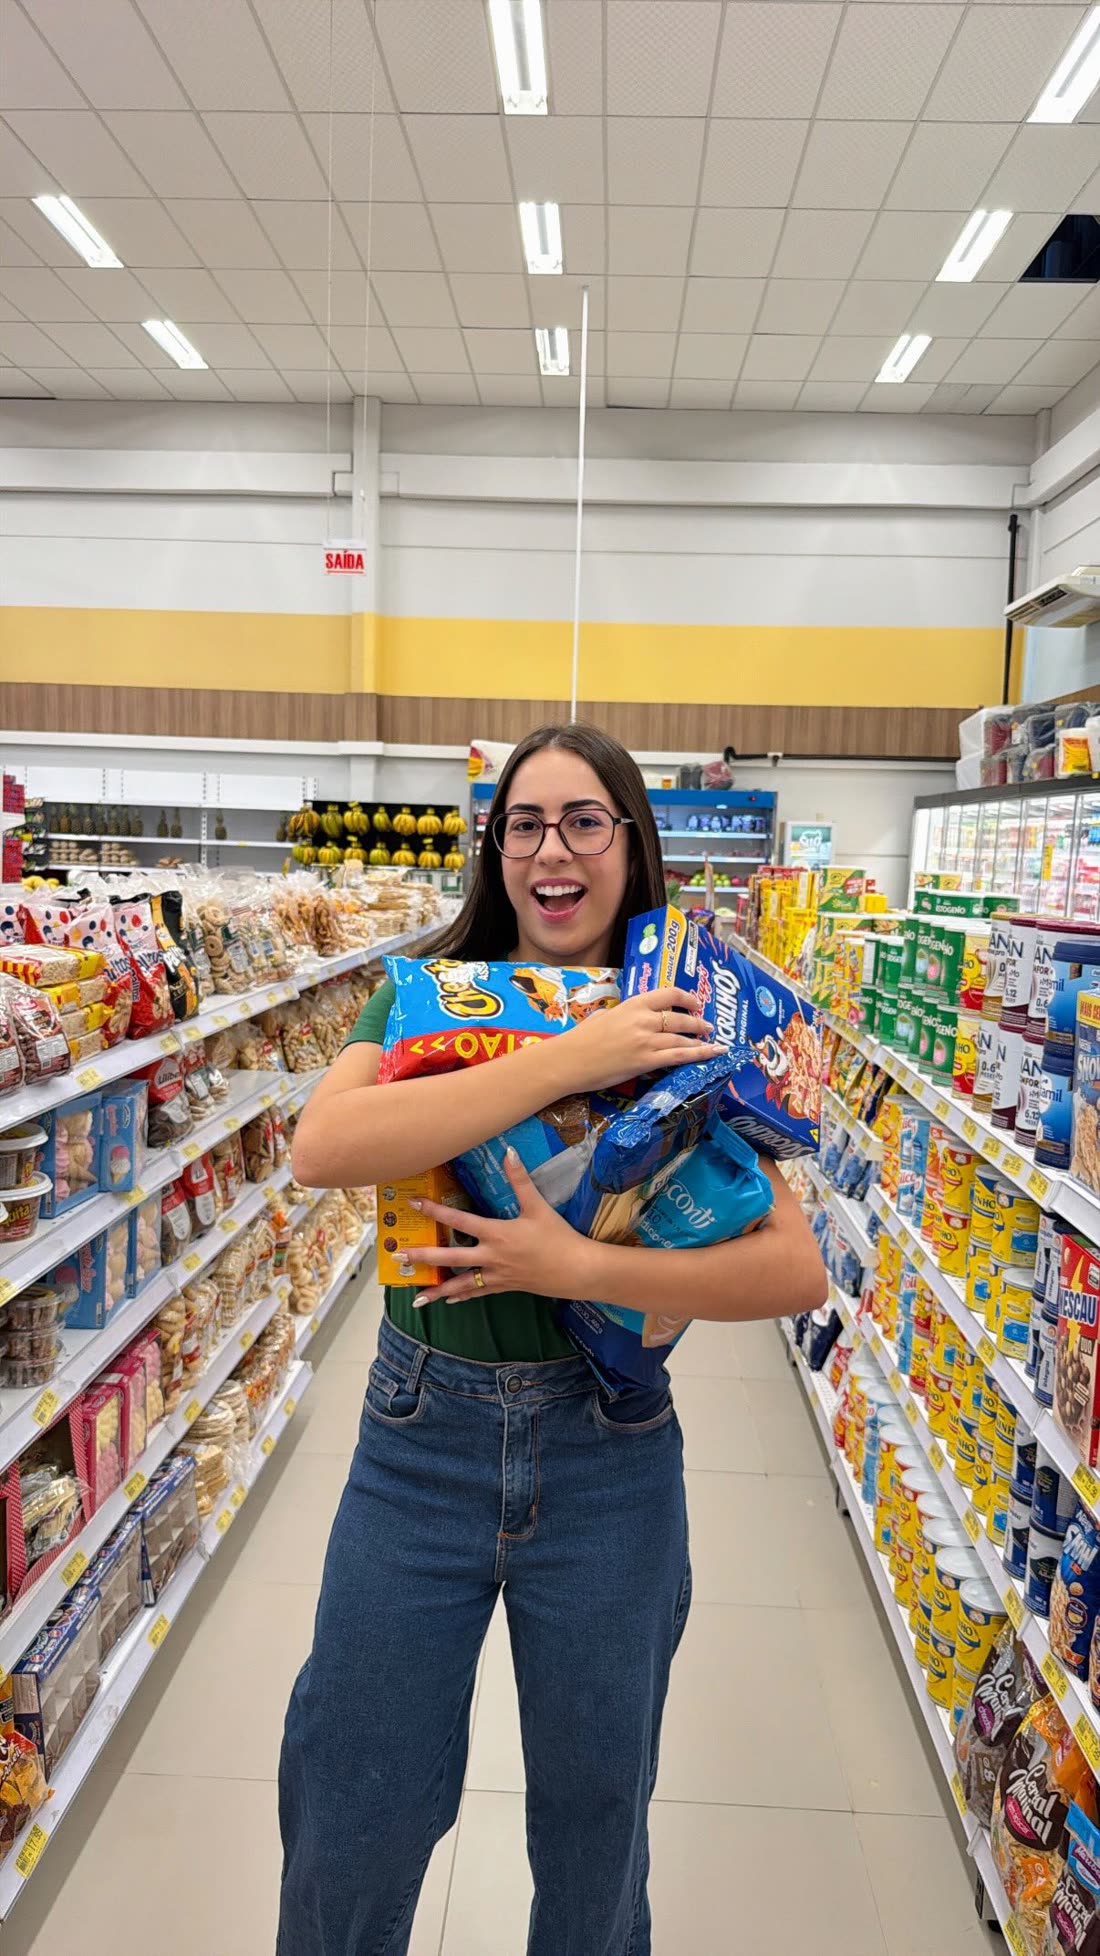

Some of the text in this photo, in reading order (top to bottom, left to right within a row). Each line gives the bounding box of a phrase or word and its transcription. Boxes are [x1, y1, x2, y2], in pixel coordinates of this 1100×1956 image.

[325, 549, 364, 570] SAÍDA
[667, 920, 679, 953] 200g
[713, 960, 740, 1050] UCRILHOS
[739, 999, 750, 1045] ORIGINAL
[726, 1115, 816, 1156] SUCRILHOS
[1059, 1287, 1098, 1325] NESCAU
[1006, 1769, 1053, 1845] Matinal
[1025, 1764, 1057, 1819] Cereal
